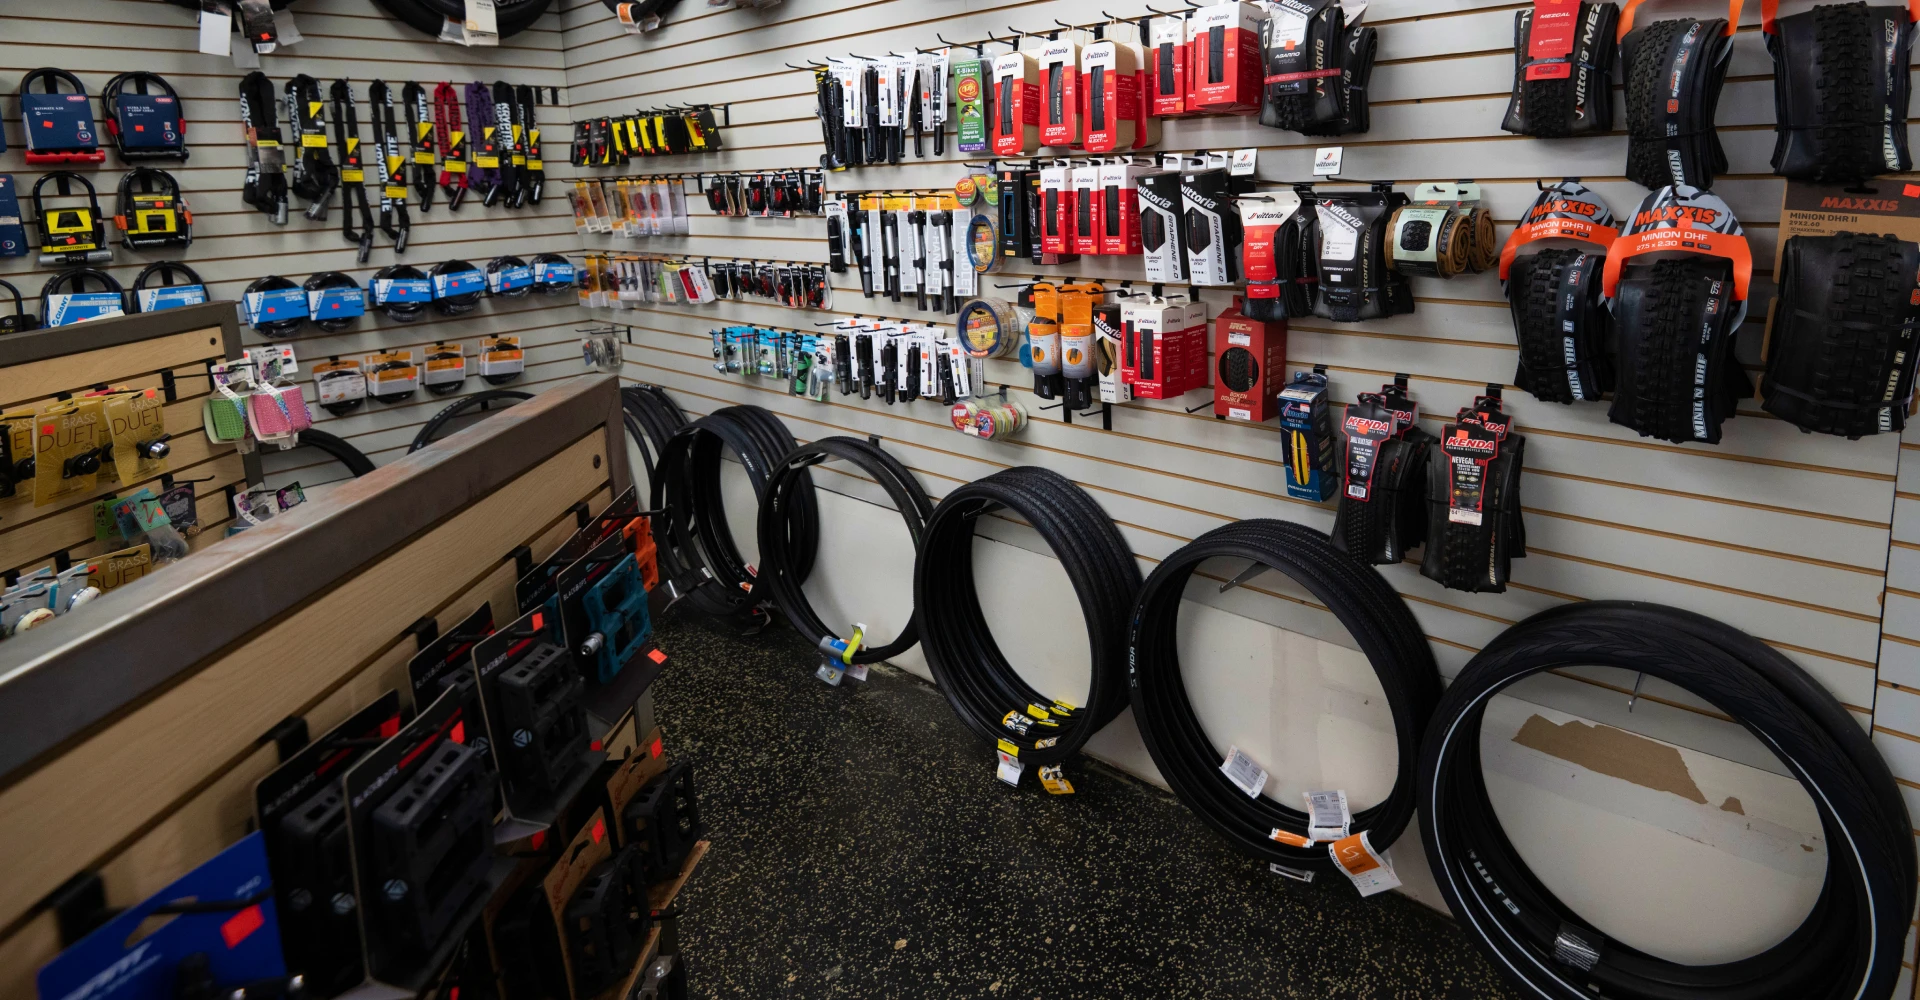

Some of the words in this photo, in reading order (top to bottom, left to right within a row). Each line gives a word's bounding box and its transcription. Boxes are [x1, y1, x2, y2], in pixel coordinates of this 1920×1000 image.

[1138, 184, 1173, 209] vittoria
[1181, 183, 1218, 211] vittoria
[1820, 196, 1899, 212] MAXXIS
[1256, 211, 1284, 220] vittoria
[1330, 203, 1362, 228] vittoria
[1530, 199, 1597, 219] MAXXIS
[1634, 206, 1717, 227] MAXXIS
[1789, 213, 1826, 222] MINION
[1530, 221, 1560, 232] MINION
[1561, 221, 1585, 231] DHR
[1641, 231, 1681, 243] MINION
[1684, 231, 1709, 242] DHF
[55, 296, 69, 319] GIANT
[1093, 314, 1122, 339] vittoria
[130, 397, 161, 413] BRASS
[953, 408, 967, 417] STOP
[62, 412, 98, 429] BRASS
[112, 405, 161, 436] DUET
[1345, 415, 1390, 432] KENDA
[39, 422, 98, 453] DUET
[1446, 436, 1495, 450] KENDA
[1452, 455, 1476, 465] NEVEGAL
[1475, 458, 1486, 467] PRO
[108, 553, 149, 573] BRASS
[1473, 861, 1521, 915] WTB
